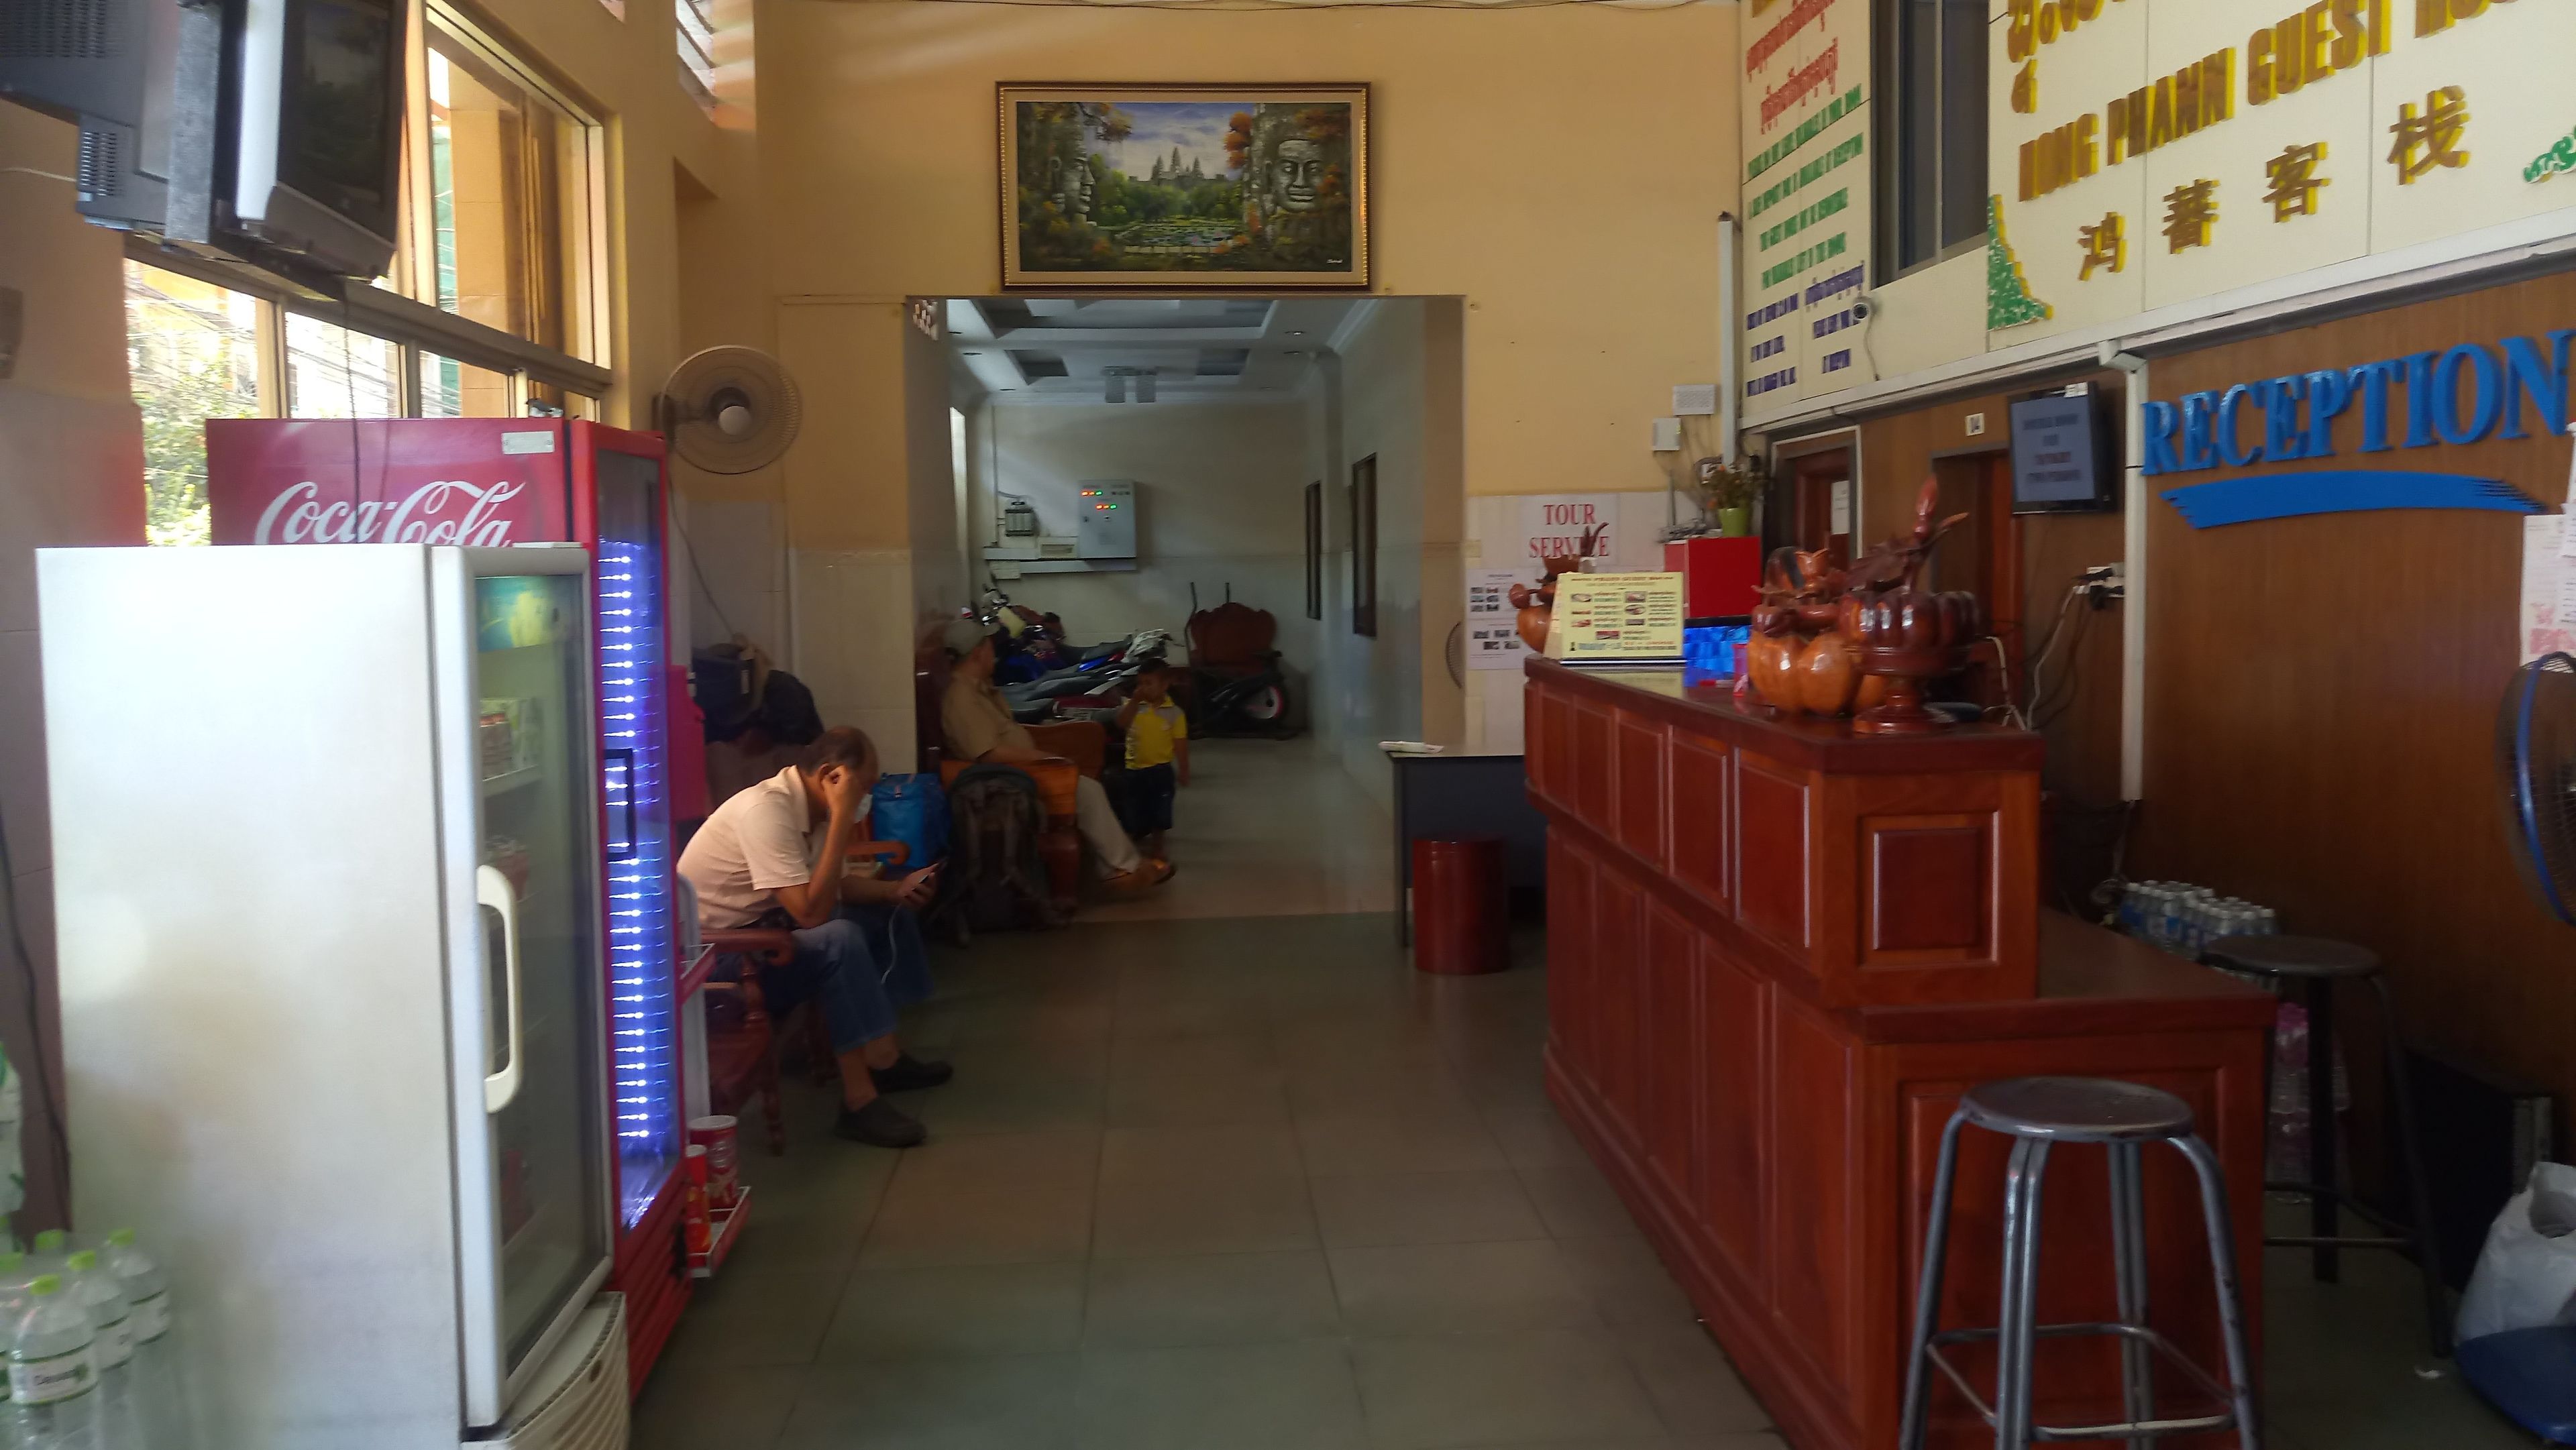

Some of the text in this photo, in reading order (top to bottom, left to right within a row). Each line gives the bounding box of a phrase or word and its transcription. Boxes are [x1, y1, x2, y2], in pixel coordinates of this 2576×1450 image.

[2141, 329, 2576, 475] RECEPTION
[255, 480, 526, 547] Coca-Cola
[1543, 504, 1597, 526] TOUR
[1529, 535, 1611, 559] SERVE
